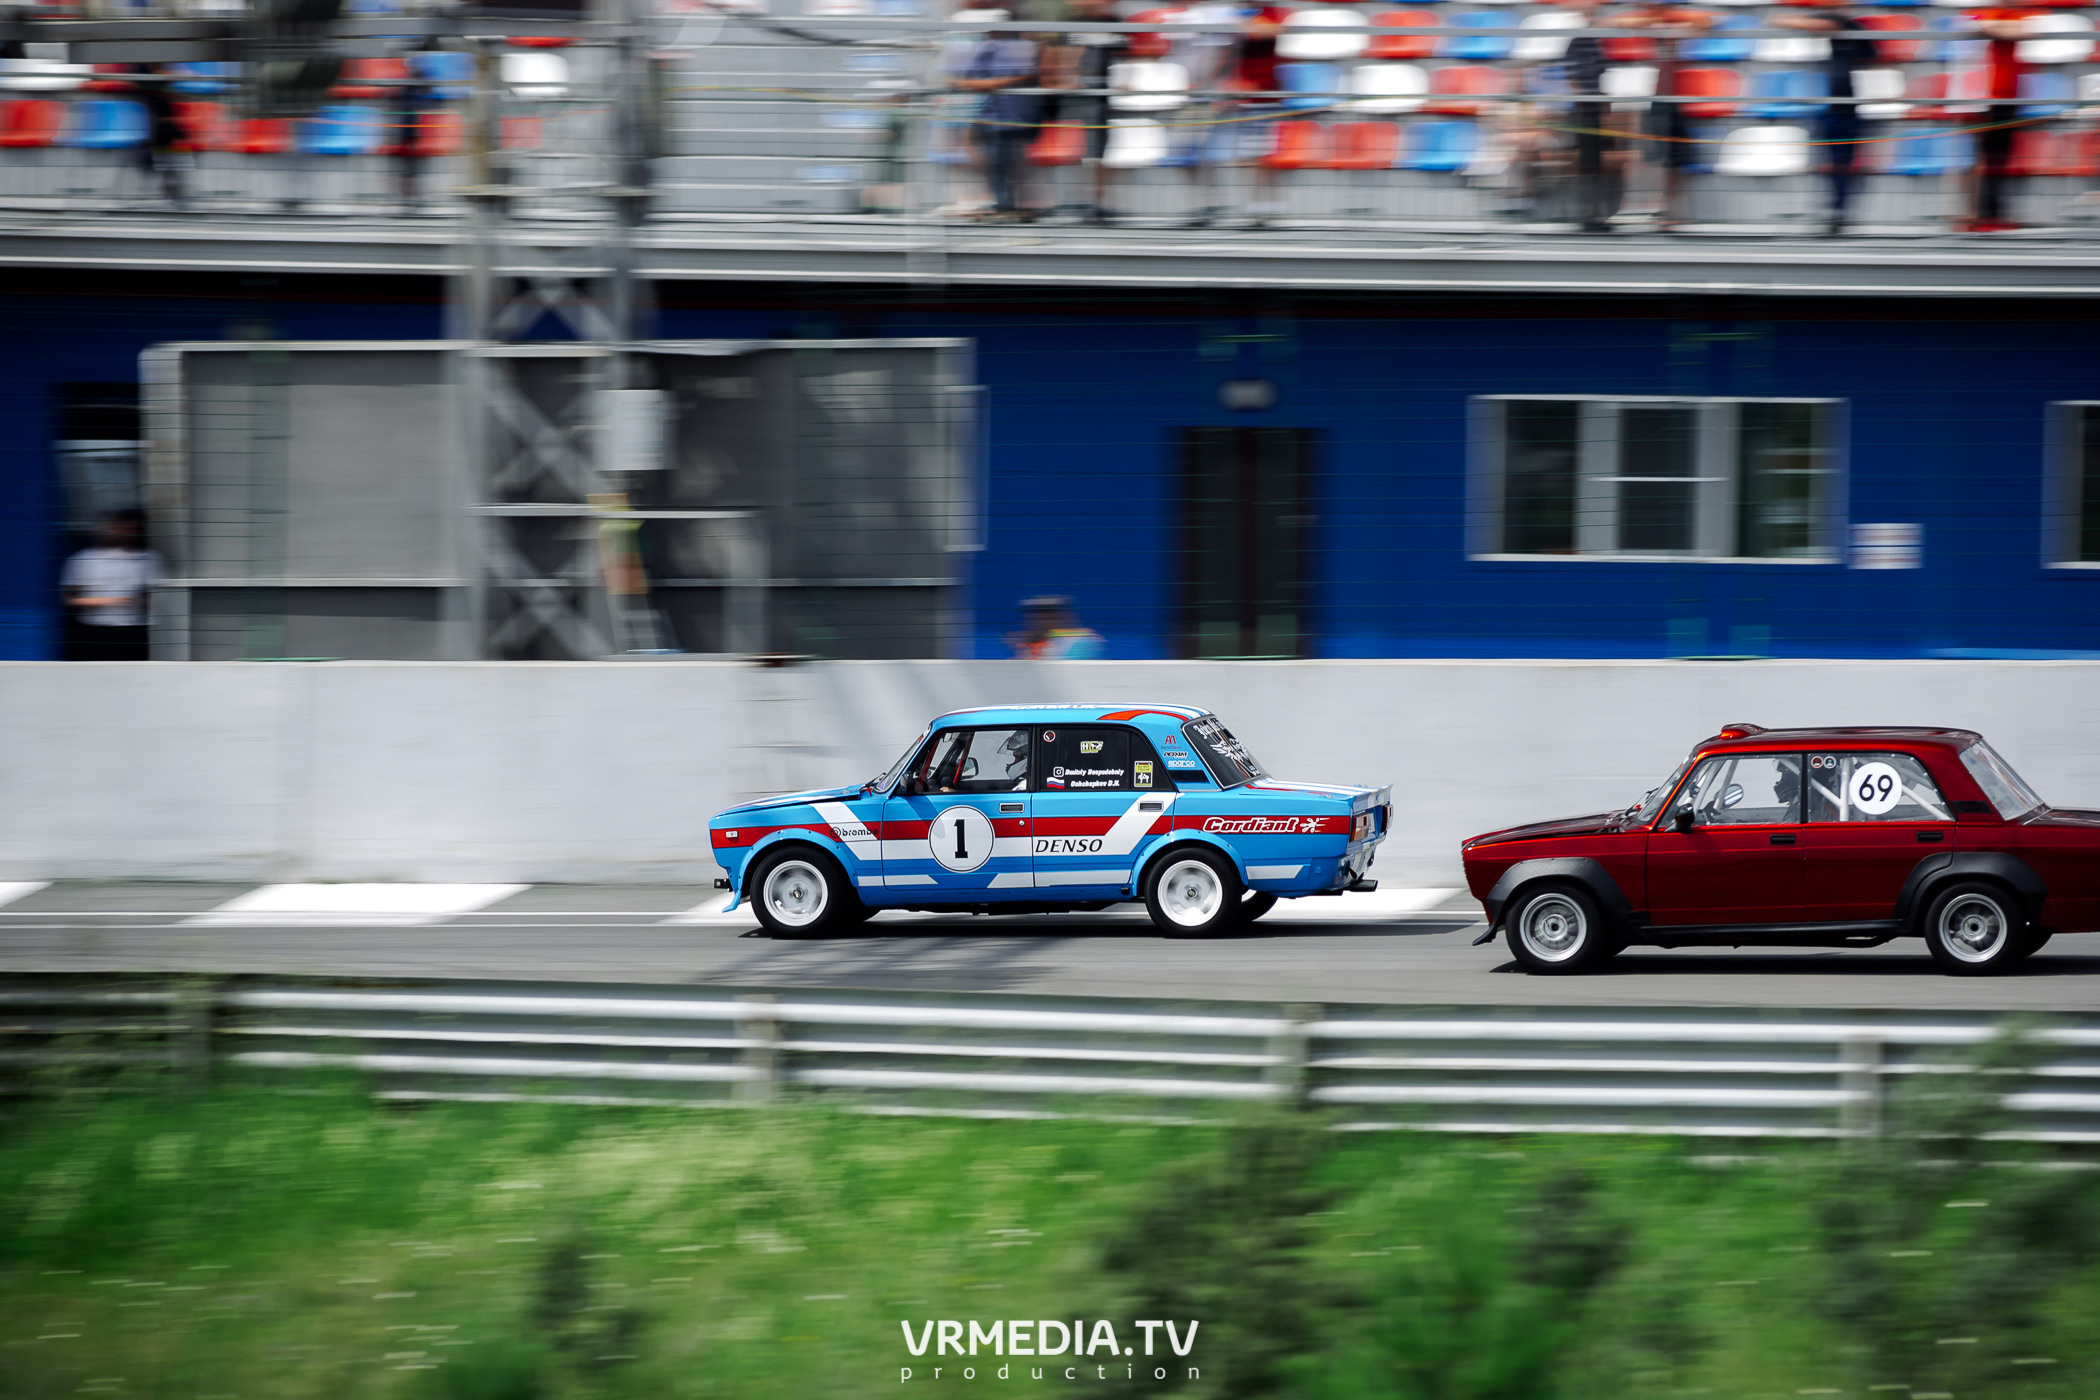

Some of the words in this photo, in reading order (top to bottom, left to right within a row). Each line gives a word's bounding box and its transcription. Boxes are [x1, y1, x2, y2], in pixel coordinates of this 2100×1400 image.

[1168, 760, 1195, 768] sparco
[1859, 774, 1893, 802] 69
[842, 827, 878, 837] brembo
[1203, 817, 1299, 833] Cordiant
[954, 819, 968, 858] 1
[1035, 839, 1102, 853] DENSO
